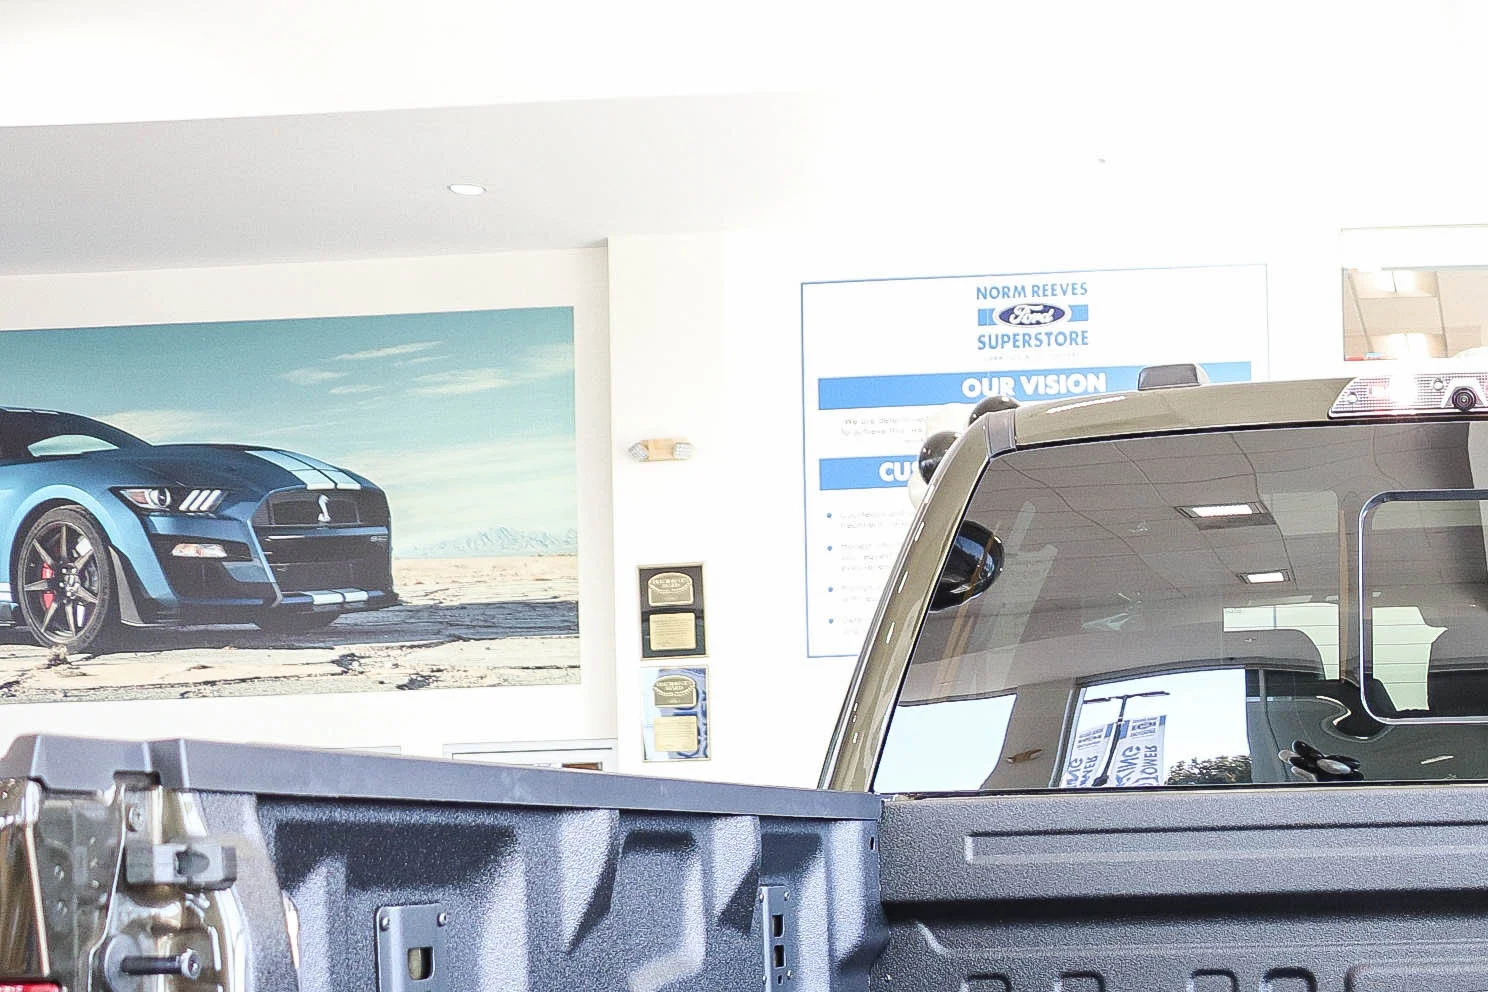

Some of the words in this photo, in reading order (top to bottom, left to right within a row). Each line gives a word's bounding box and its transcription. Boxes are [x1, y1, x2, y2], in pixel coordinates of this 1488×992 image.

[976, 285, 1027, 300] NORM
[1031, 282, 1088, 298] REEVES
[1008, 303, 1055, 325] Ford
[977, 330, 1089, 350] SUPERSTORE
[961, 376, 1016, 398] OUR
[1019, 372, 1107, 395] VISION
